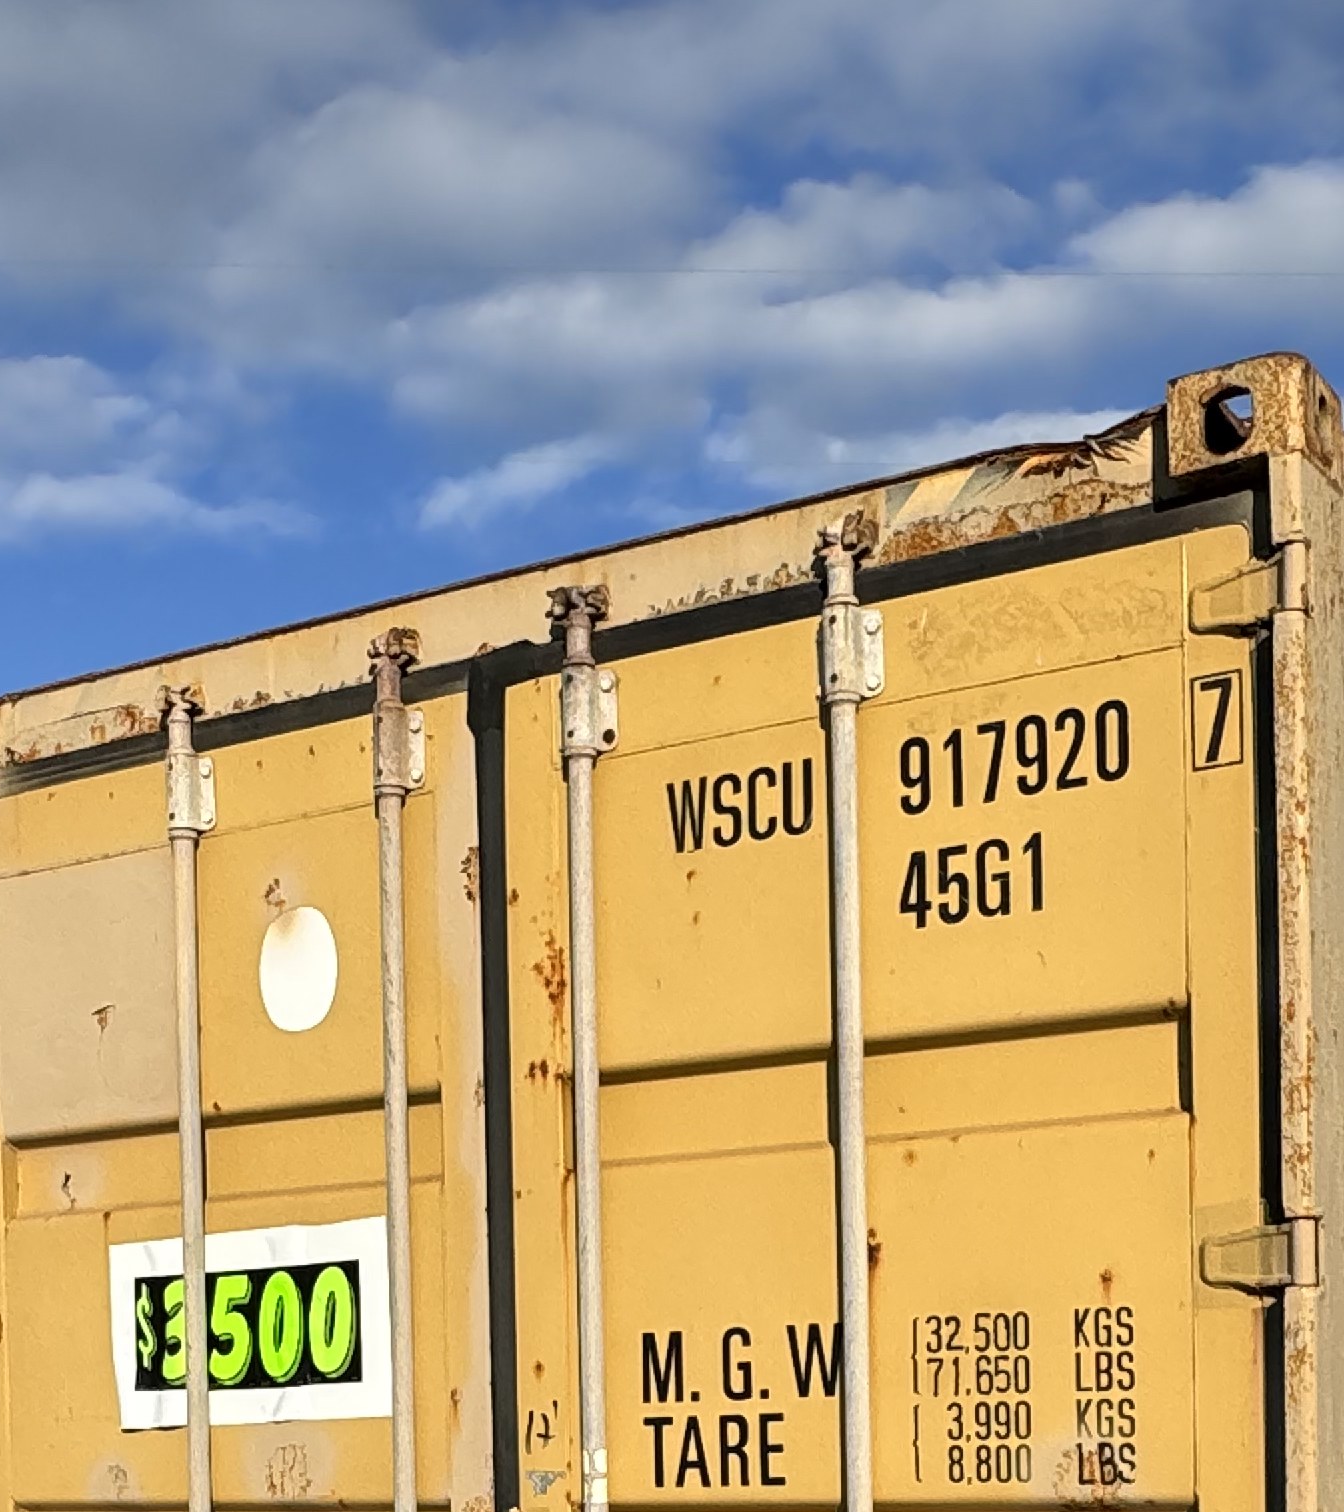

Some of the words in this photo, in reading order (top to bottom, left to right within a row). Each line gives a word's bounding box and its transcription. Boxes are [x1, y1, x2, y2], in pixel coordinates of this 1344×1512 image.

[666, 758, 814, 854] WSCU
[899, 699, 1130, 816] 917920
[1199, 678, 1234, 764] 7
[899, 832, 1044, 930] 45G1
[1074, 1306, 1135, 1349] KGS
[1074, 1350, 1136, 1393] LBS
[946, 1400, 1032, 1443] 3,990
[1075, 1398, 1136, 1439] KGS
[643, 1412, 787, 1488] TARE
[947, 1443, 1032, 1486] 8,800
[1075, 1442, 1137, 1486] LBS
